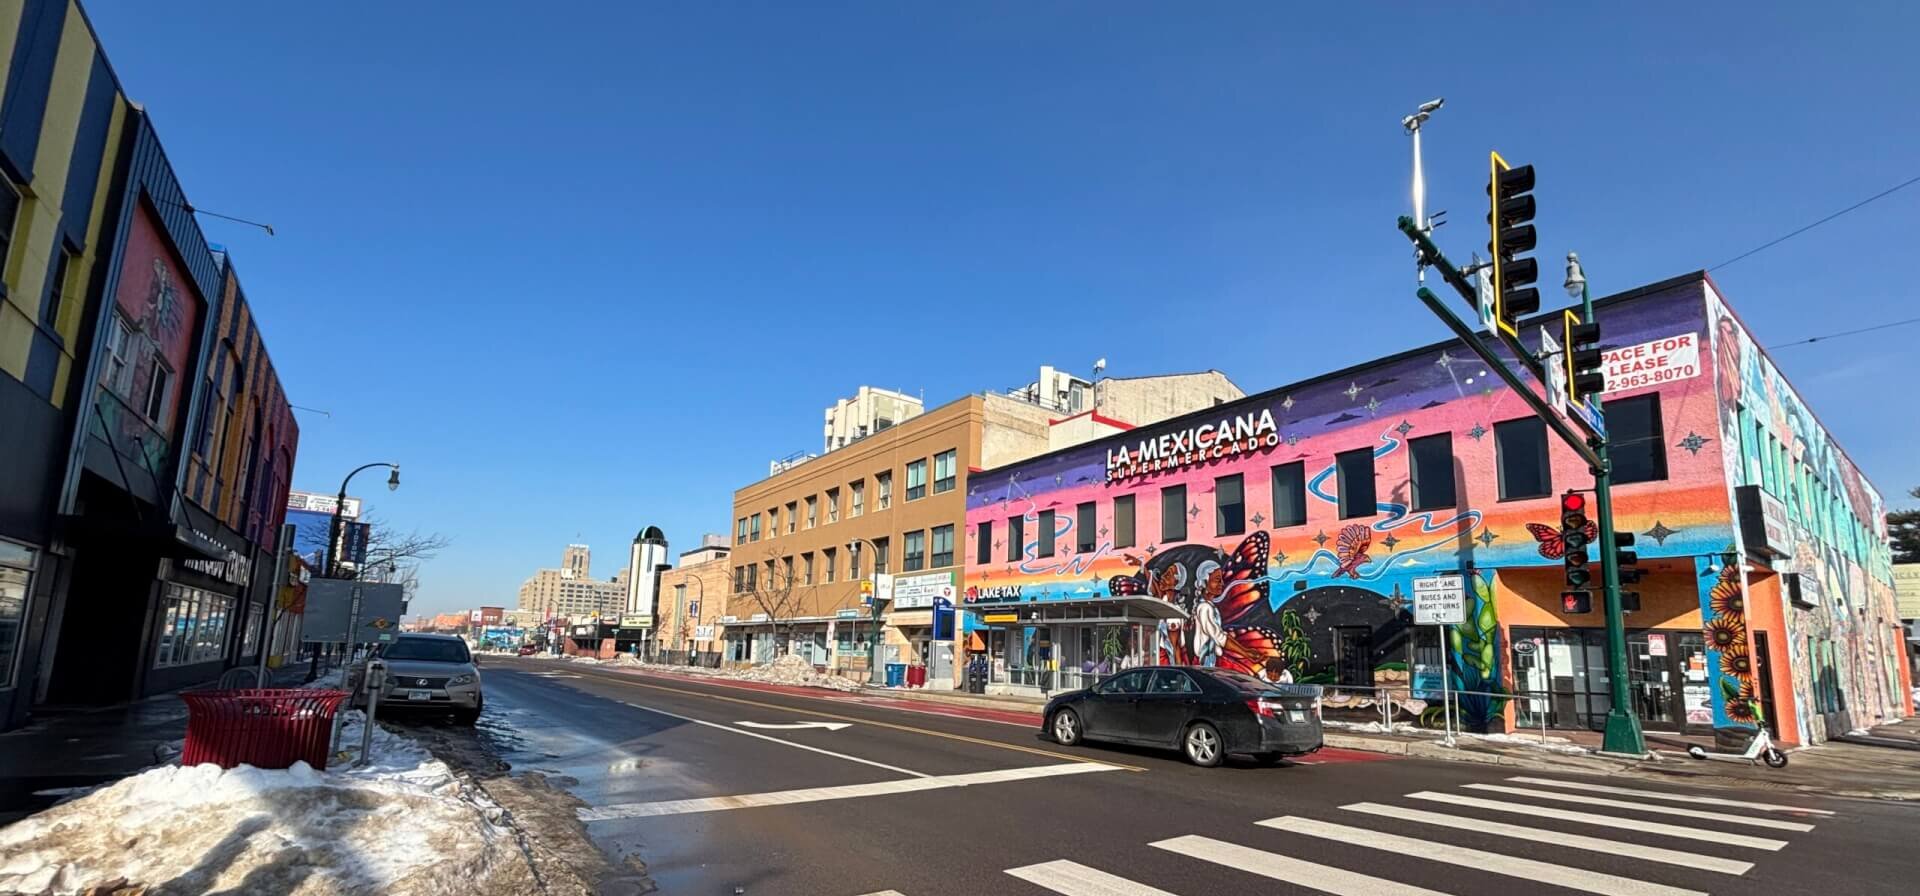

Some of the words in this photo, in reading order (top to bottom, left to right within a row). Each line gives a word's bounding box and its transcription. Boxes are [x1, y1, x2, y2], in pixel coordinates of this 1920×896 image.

[1600, 346, 1645, 363] PACE
[1652, 336, 1691, 354] FOR
[1607, 364, 1694, 391] 2-963-8070
[1610, 355, 1669, 377] LEASE
[1106, 446, 1131, 470] LA
[1137, 408, 1277, 461] MEXICANA
[1107, 433, 1278, 481] SUPERMERCADO
[978, 586, 1000, 599] LAKE
[1001, 585, 1020, 598] TAX
